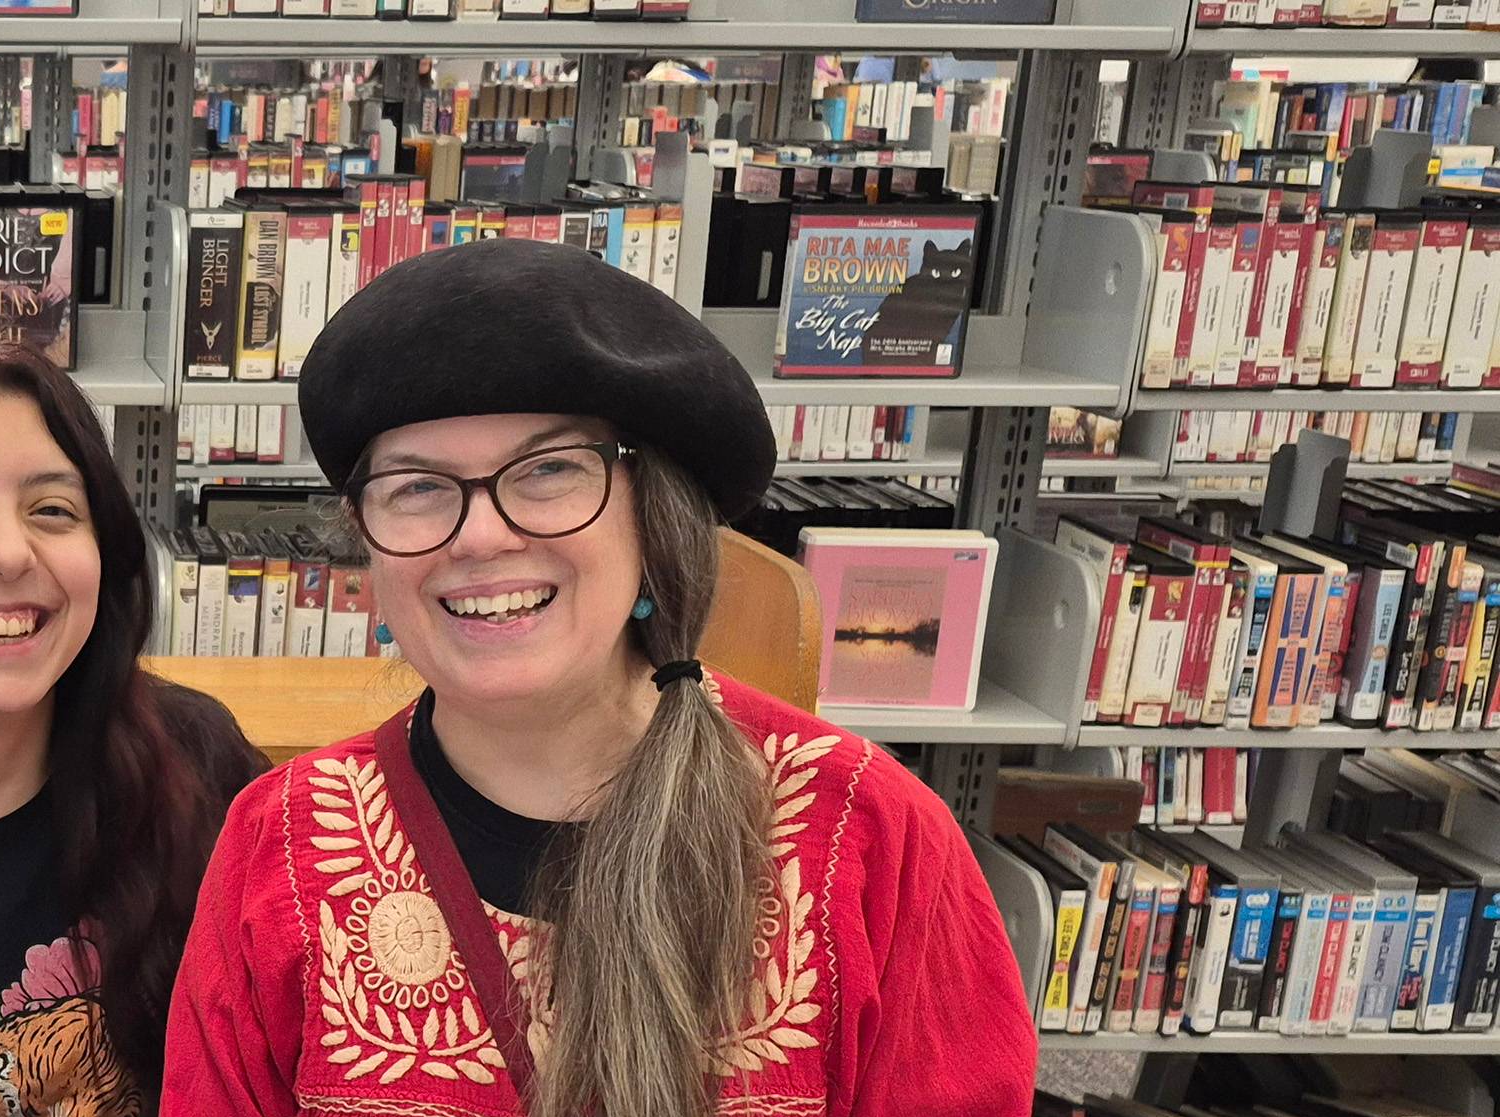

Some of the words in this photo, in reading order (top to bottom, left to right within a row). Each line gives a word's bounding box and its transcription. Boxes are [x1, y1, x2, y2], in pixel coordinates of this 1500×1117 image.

[45, 220, 62, 228] NEW
[258, 220, 279, 240] DAN
[806, 236, 854, 257] RITA
[863, 237, 912, 257] MAE
[200, 238, 216, 309] BRINGER
[215, 238, 230, 287] LIGHT
[256, 244, 278, 278] BROWN
[802, 257, 908, 285] BROWN
[822, 294, 850, 310] The
[869, 286, 904, 294] BROWN
[796, 308, 836, 336] Big
[840, 309, 880, 332] Cat
[816, 330, 864, 359] Nap
[214, 600, 222, 638] SANDRA
[1382, 602, 1392, 617] LEE
[1378, 618, 1390, 640] CHILD
[1348, 944, 1362, 980] CLANCY
[1374, 945, 1390, 982] CLANCY
